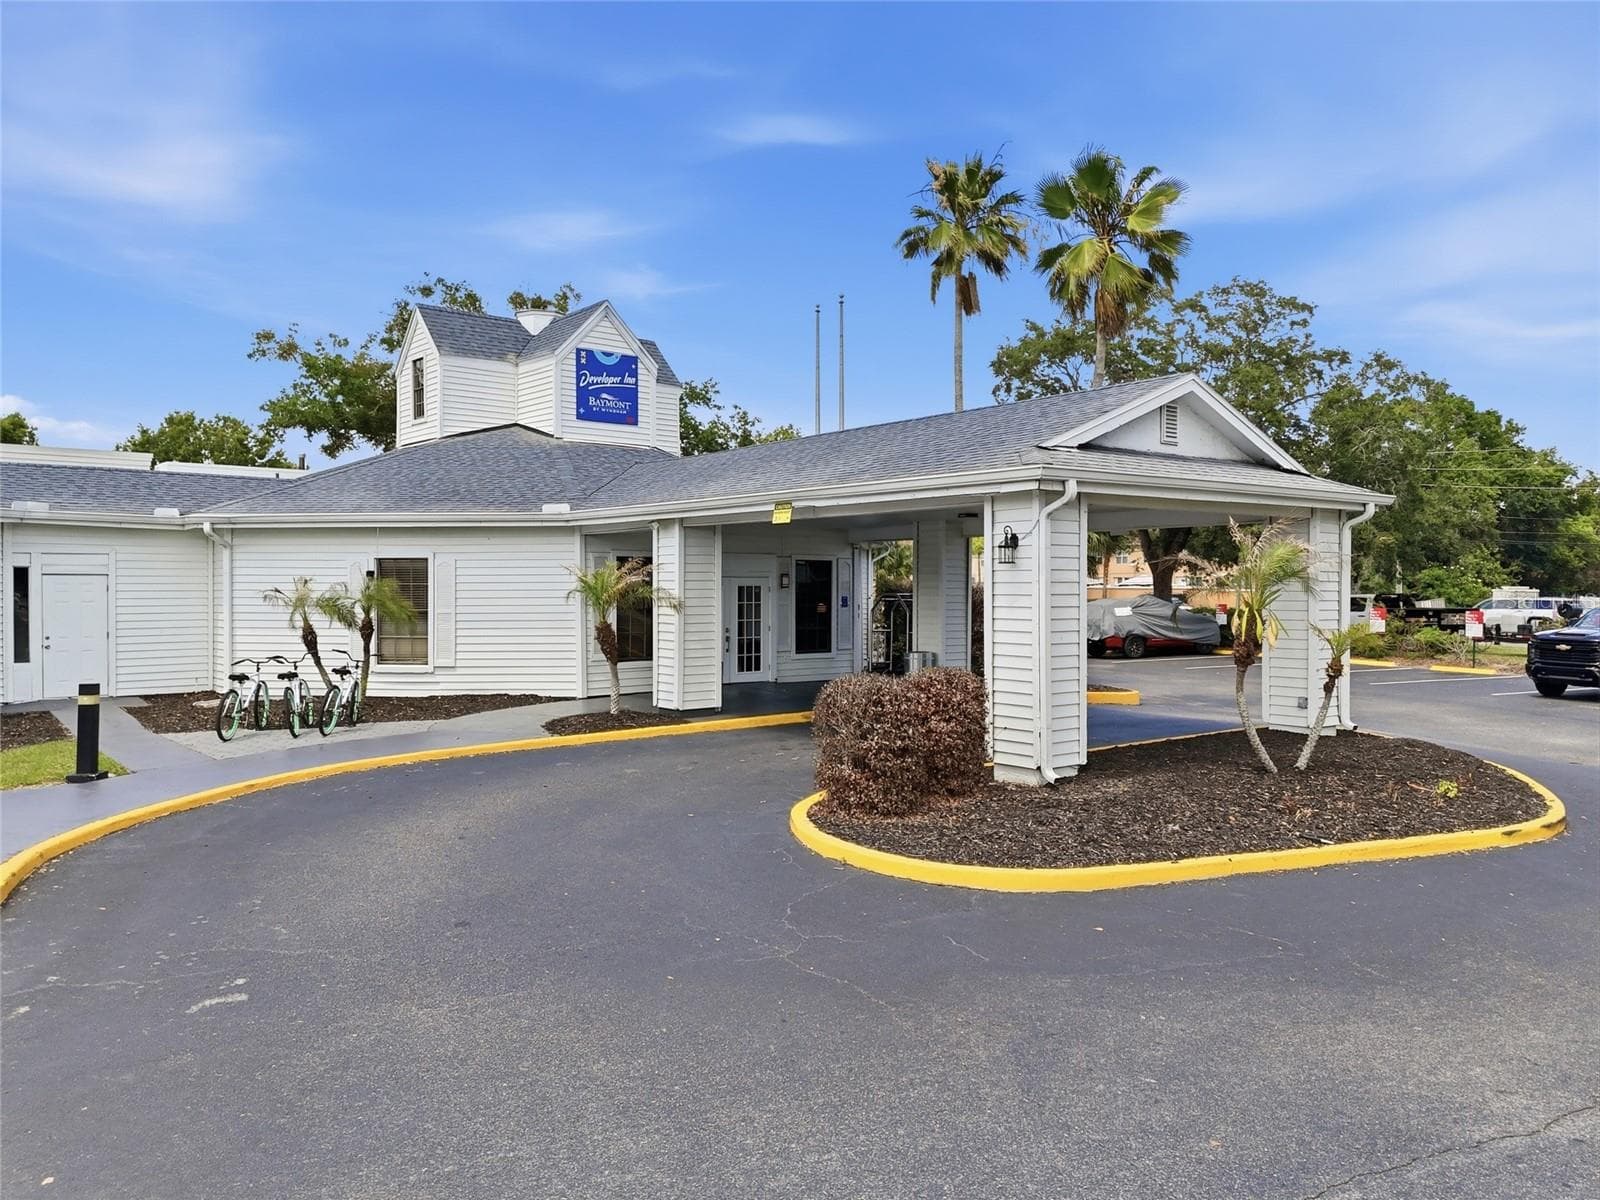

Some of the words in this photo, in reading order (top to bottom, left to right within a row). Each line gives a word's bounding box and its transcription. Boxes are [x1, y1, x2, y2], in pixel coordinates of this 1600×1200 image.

[579, 370, 622, 387] Developer
[623, 372, 636, 384] Inn
[588, 396, 632, 410] BAYMONT
